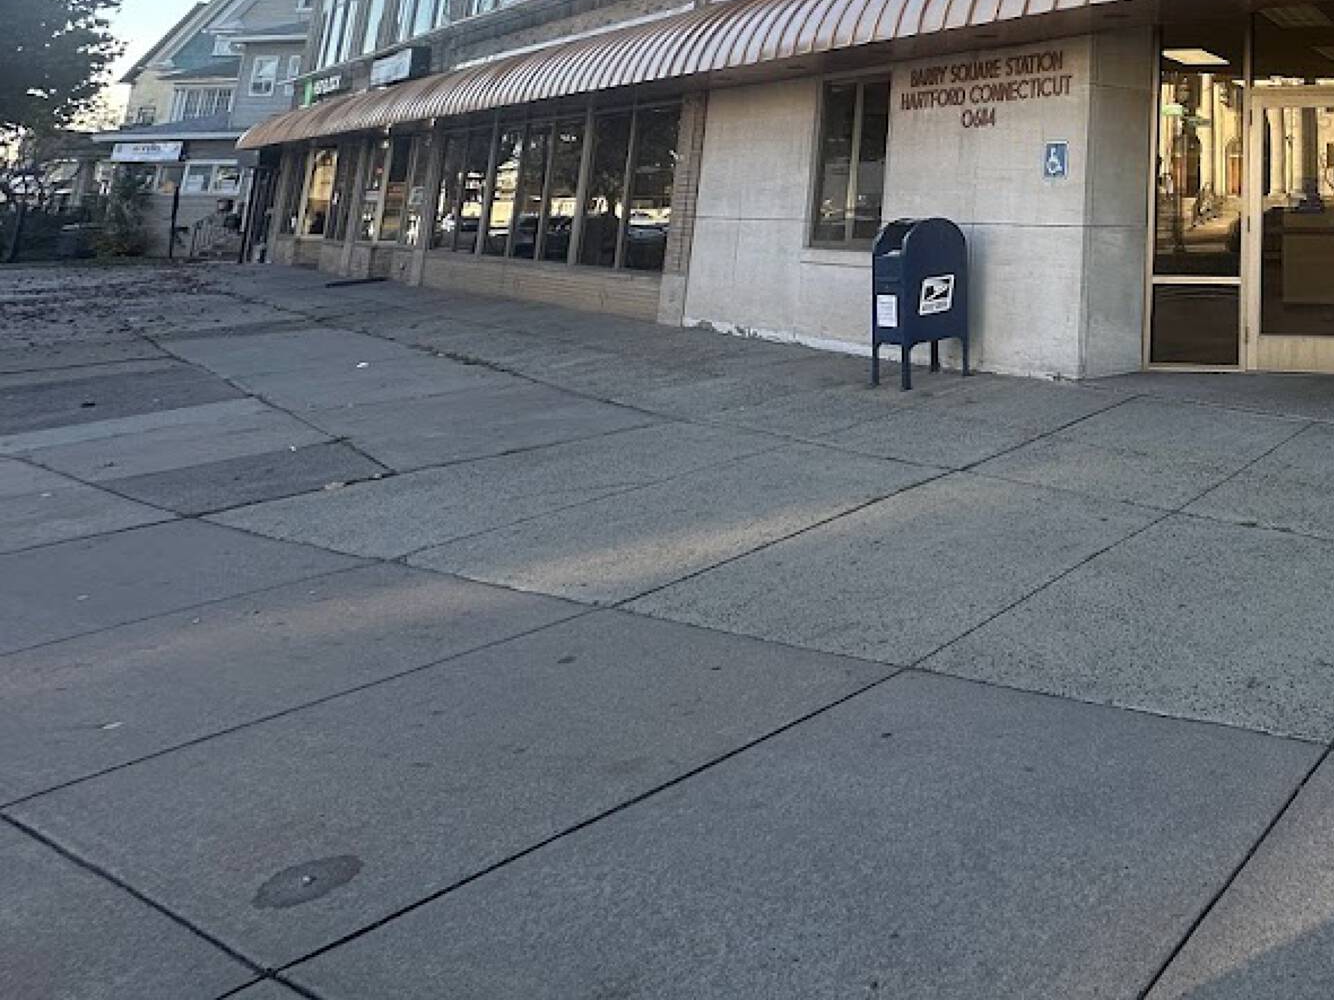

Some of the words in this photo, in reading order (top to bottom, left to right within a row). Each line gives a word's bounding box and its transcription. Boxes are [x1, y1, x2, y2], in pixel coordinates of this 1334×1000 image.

[910, 65, 948, 87] BARRY
[951, 58, 1001, 83] SQUARE
[1005, 50, 1063, 76] STATION
[901, 87, 966, 110] HARTFORD
[969, 75, 1073, 104] CONNECTICUT
